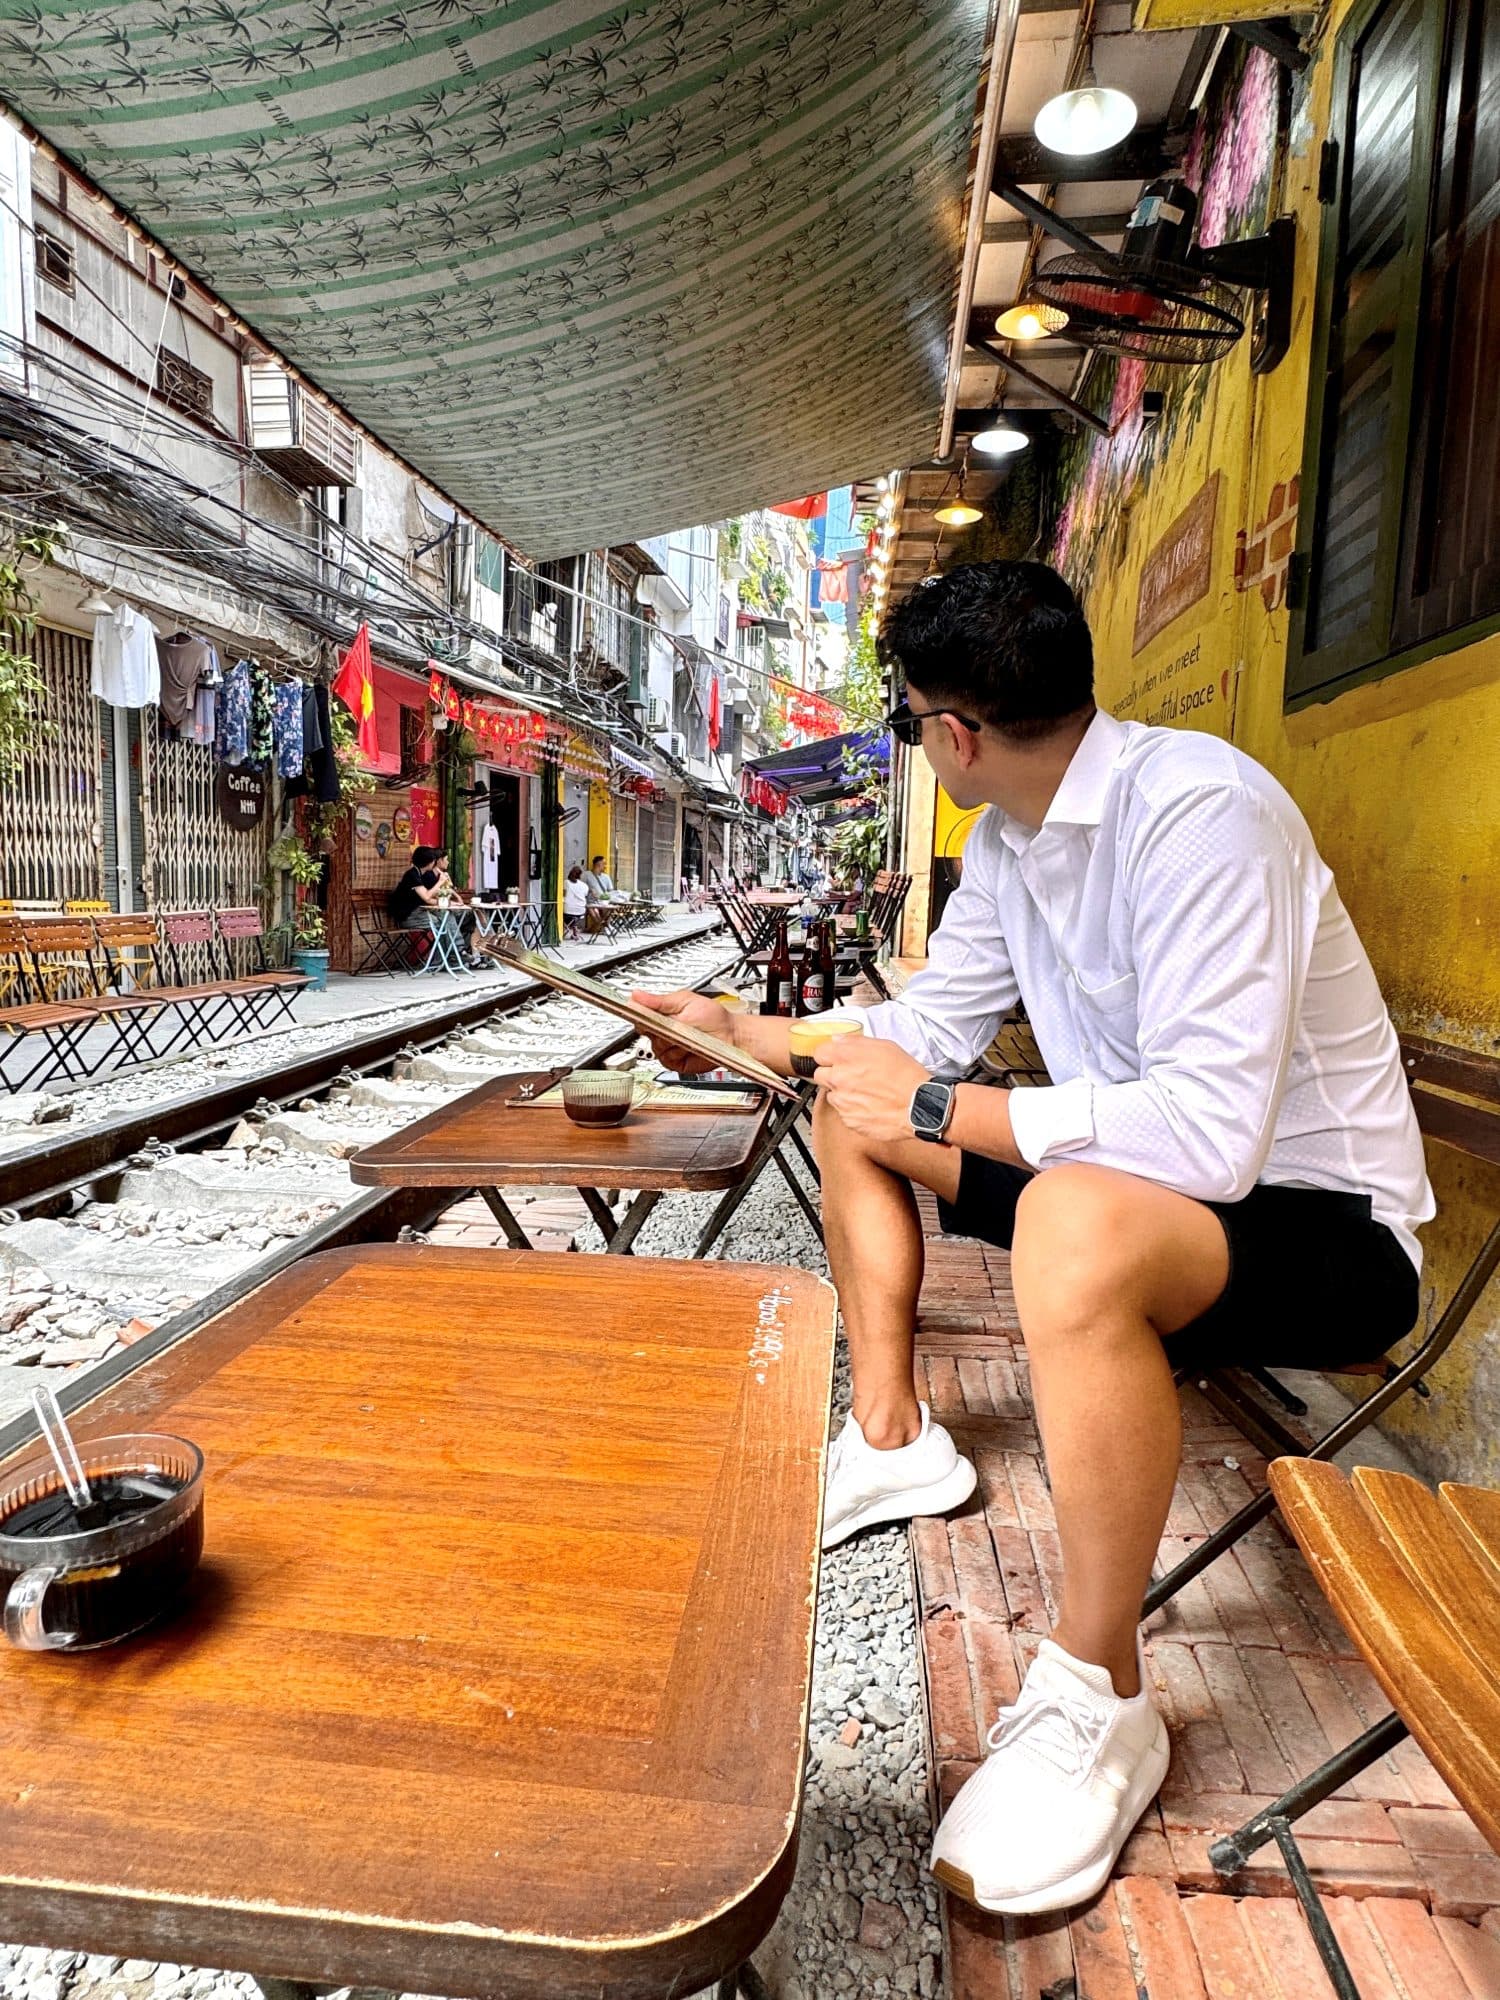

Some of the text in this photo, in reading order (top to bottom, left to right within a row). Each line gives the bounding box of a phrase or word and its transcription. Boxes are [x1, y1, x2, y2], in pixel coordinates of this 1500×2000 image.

[1175, 633, 1201, 674] meet
[1179, 684, 1215, 724] space
[228, 773, 261, 794] Coffee
